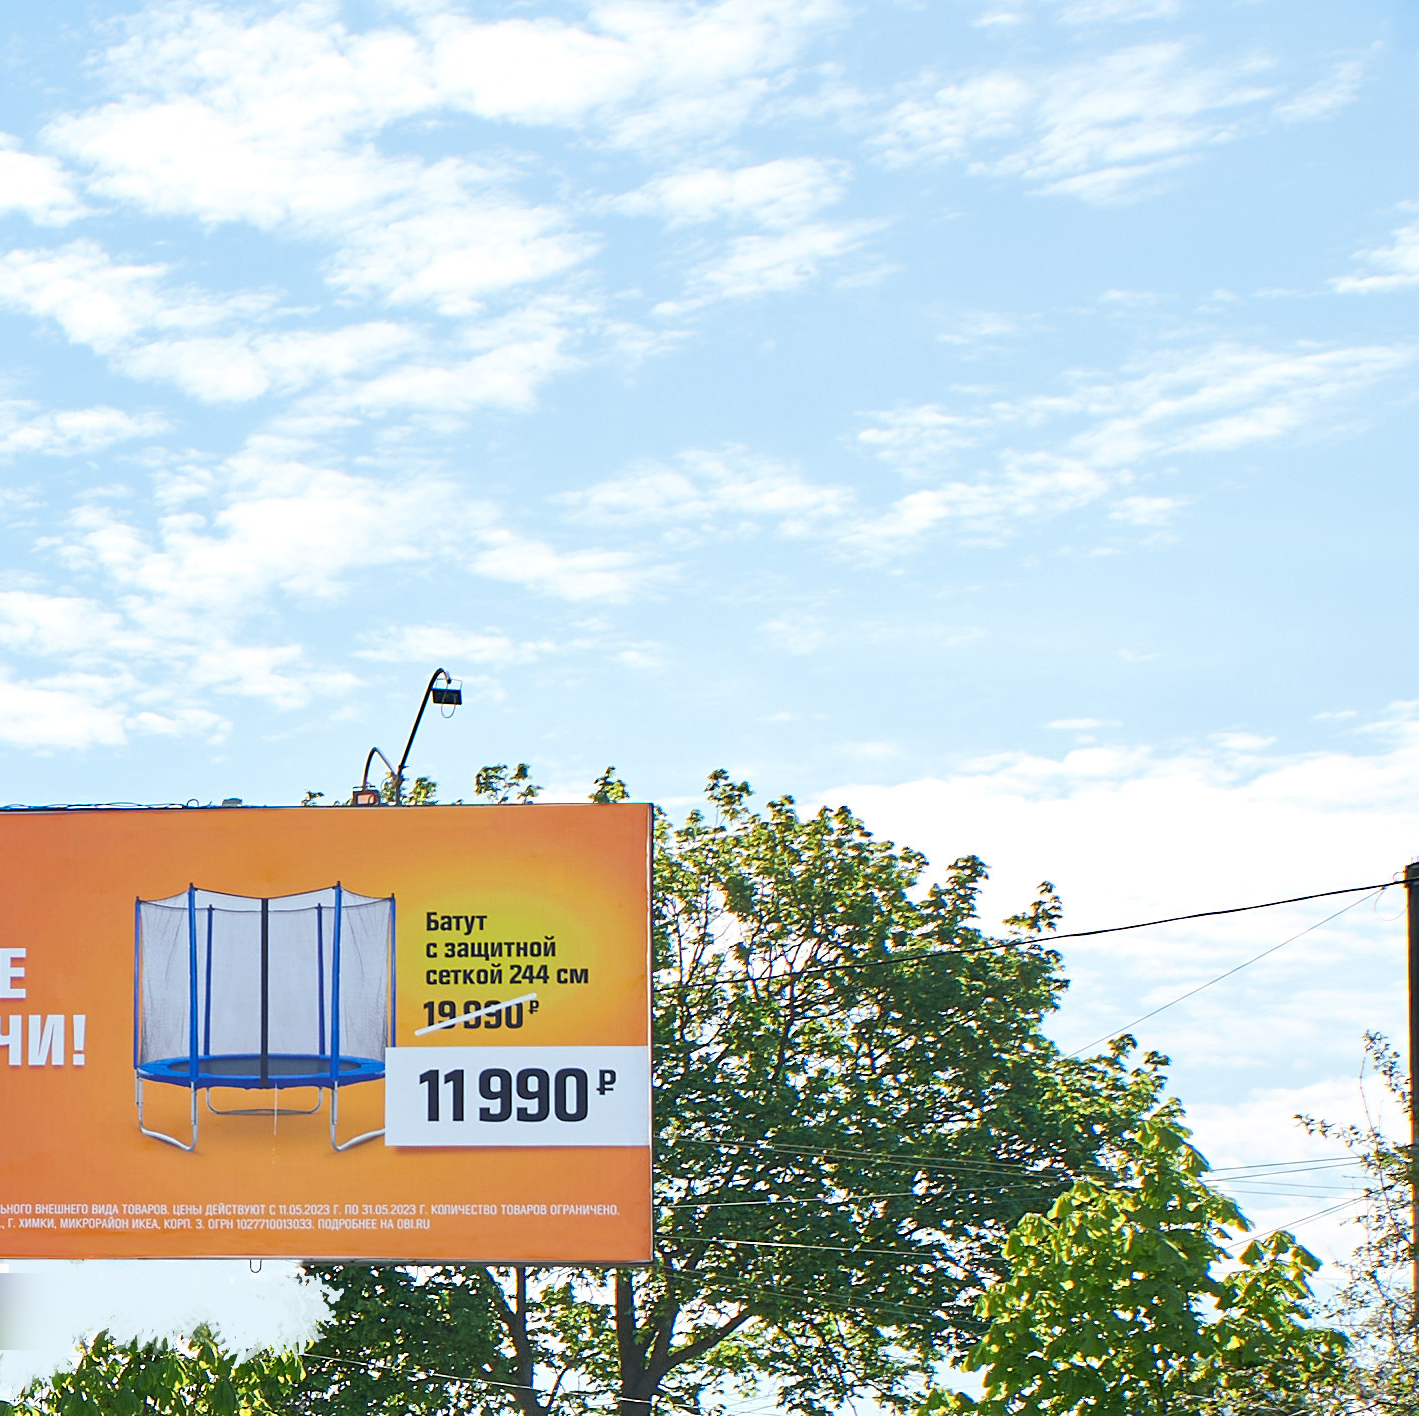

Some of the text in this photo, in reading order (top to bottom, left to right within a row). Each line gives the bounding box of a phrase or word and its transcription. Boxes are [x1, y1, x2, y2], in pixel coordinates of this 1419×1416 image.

[425, 911, 488, 936] Батут
[425, 935, 557, 961] с защитной
[425, 962, 590, 986] сеткой 244 см
[34, 1203, 89, 1215] ВНЕШНЕГО
[91, 1203, 119, 1216] ВИДА
[121, 1203, 170, 1215] ТОВАРОВ.
[172, 1204, 203, 1217] ЦЕНЫ
[204, 1202, 266, 1217] ДЕЙСТВУЮТ
[278, 1204, 331, 1216] 11.05.2023
[361, 1203, 417, 1216] 31.05.2023
[430, 1204, 498, 1216] КОЛИЧЕСТВО
[500, 1204, 548, 1216] ТОВАРОВ
[549, 1204, 620, 1216] ОГРАНИЧЕНО.
[18, 1217, 57, 1230] ХИМКИ,
[59, 1216, 130, 1230] МИКРОРАЙОН
[131, 1218, 161, 1230] ИКЕА,
[163, 1218, 193, 1230] КОРП.
[207, 1218, 234, 1230] ОГРН
[236, 1218, 316, 1230] 1027710013033.
[317, 1218, 378, 1231] ПОДРОБНЕЕ
[396, 1218, 431, 1230] OBI.RU
